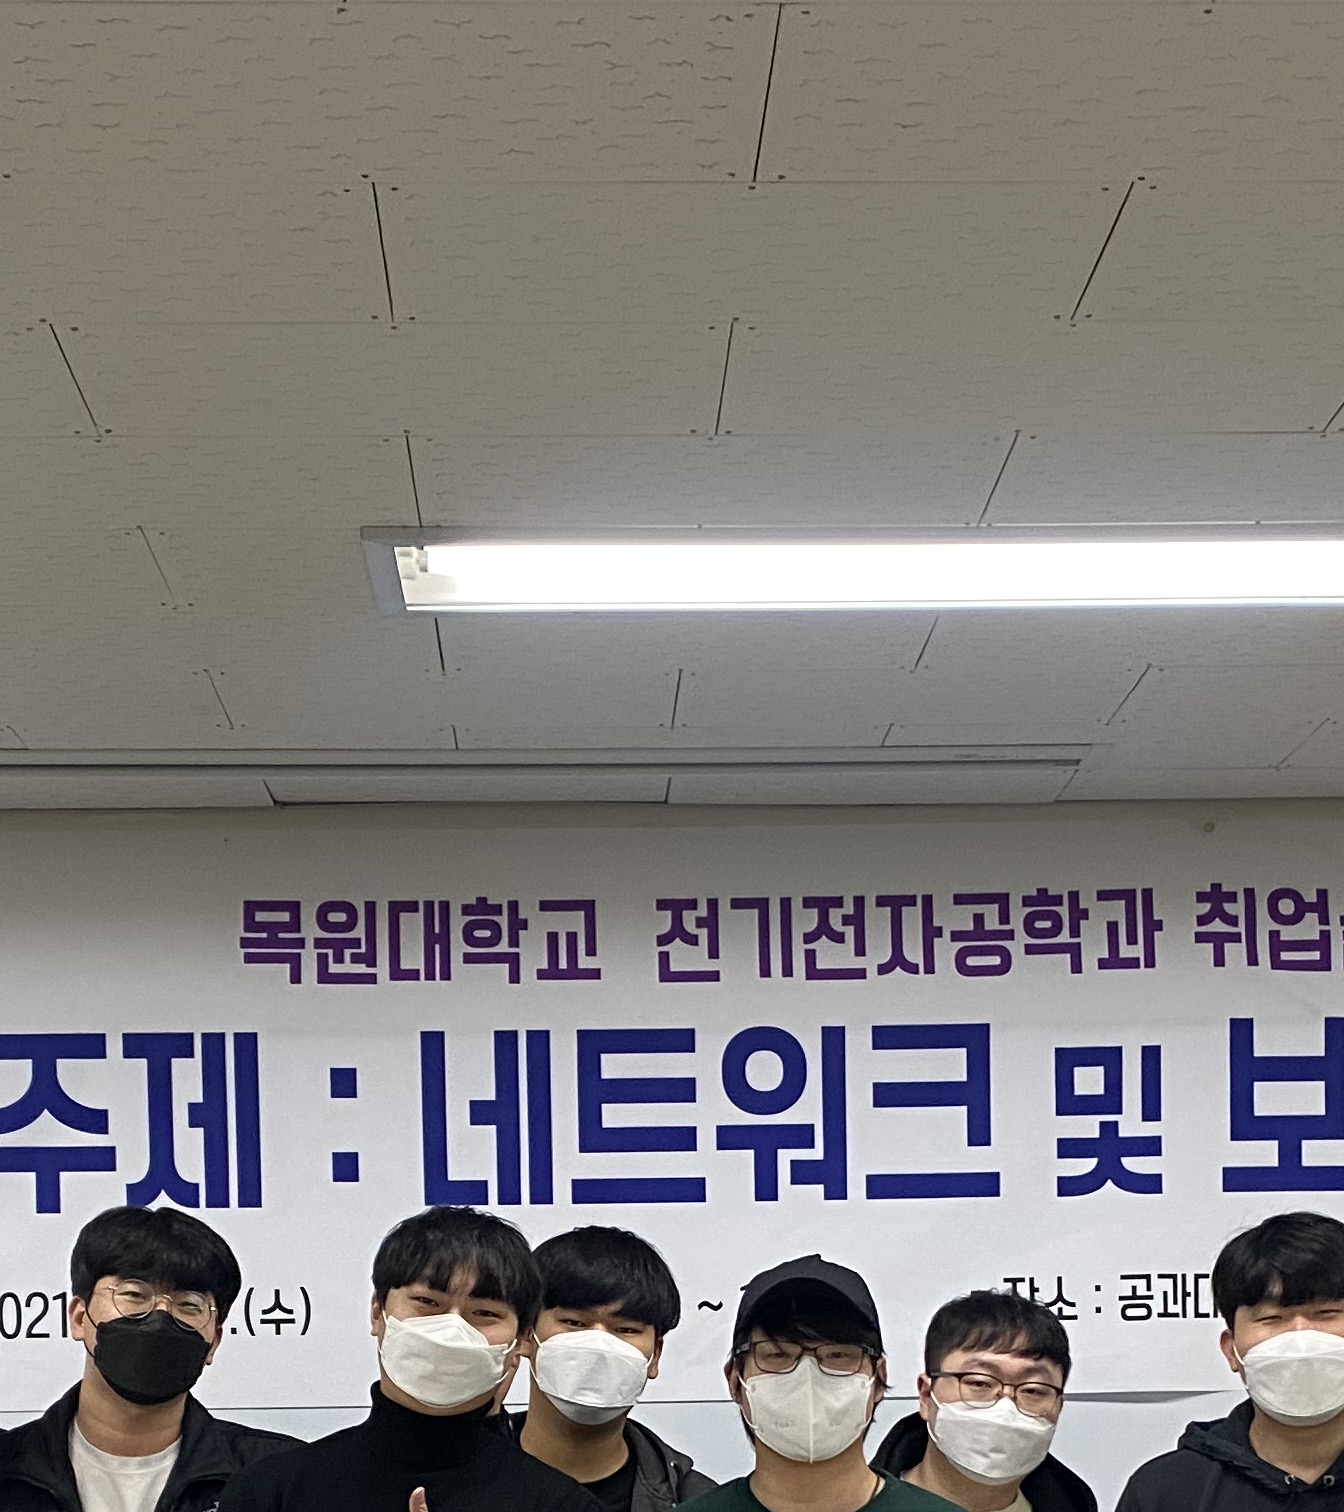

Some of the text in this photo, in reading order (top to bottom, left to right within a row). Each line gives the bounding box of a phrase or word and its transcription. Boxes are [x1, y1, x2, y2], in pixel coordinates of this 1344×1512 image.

[239, 897, 603, 987] 목원대학교
[656, 887, 1163, 984] 전기전자공학과
[420, 1021, 1002, 1206] 네트워크
[1054, 1044, 1163, 1197] 및
